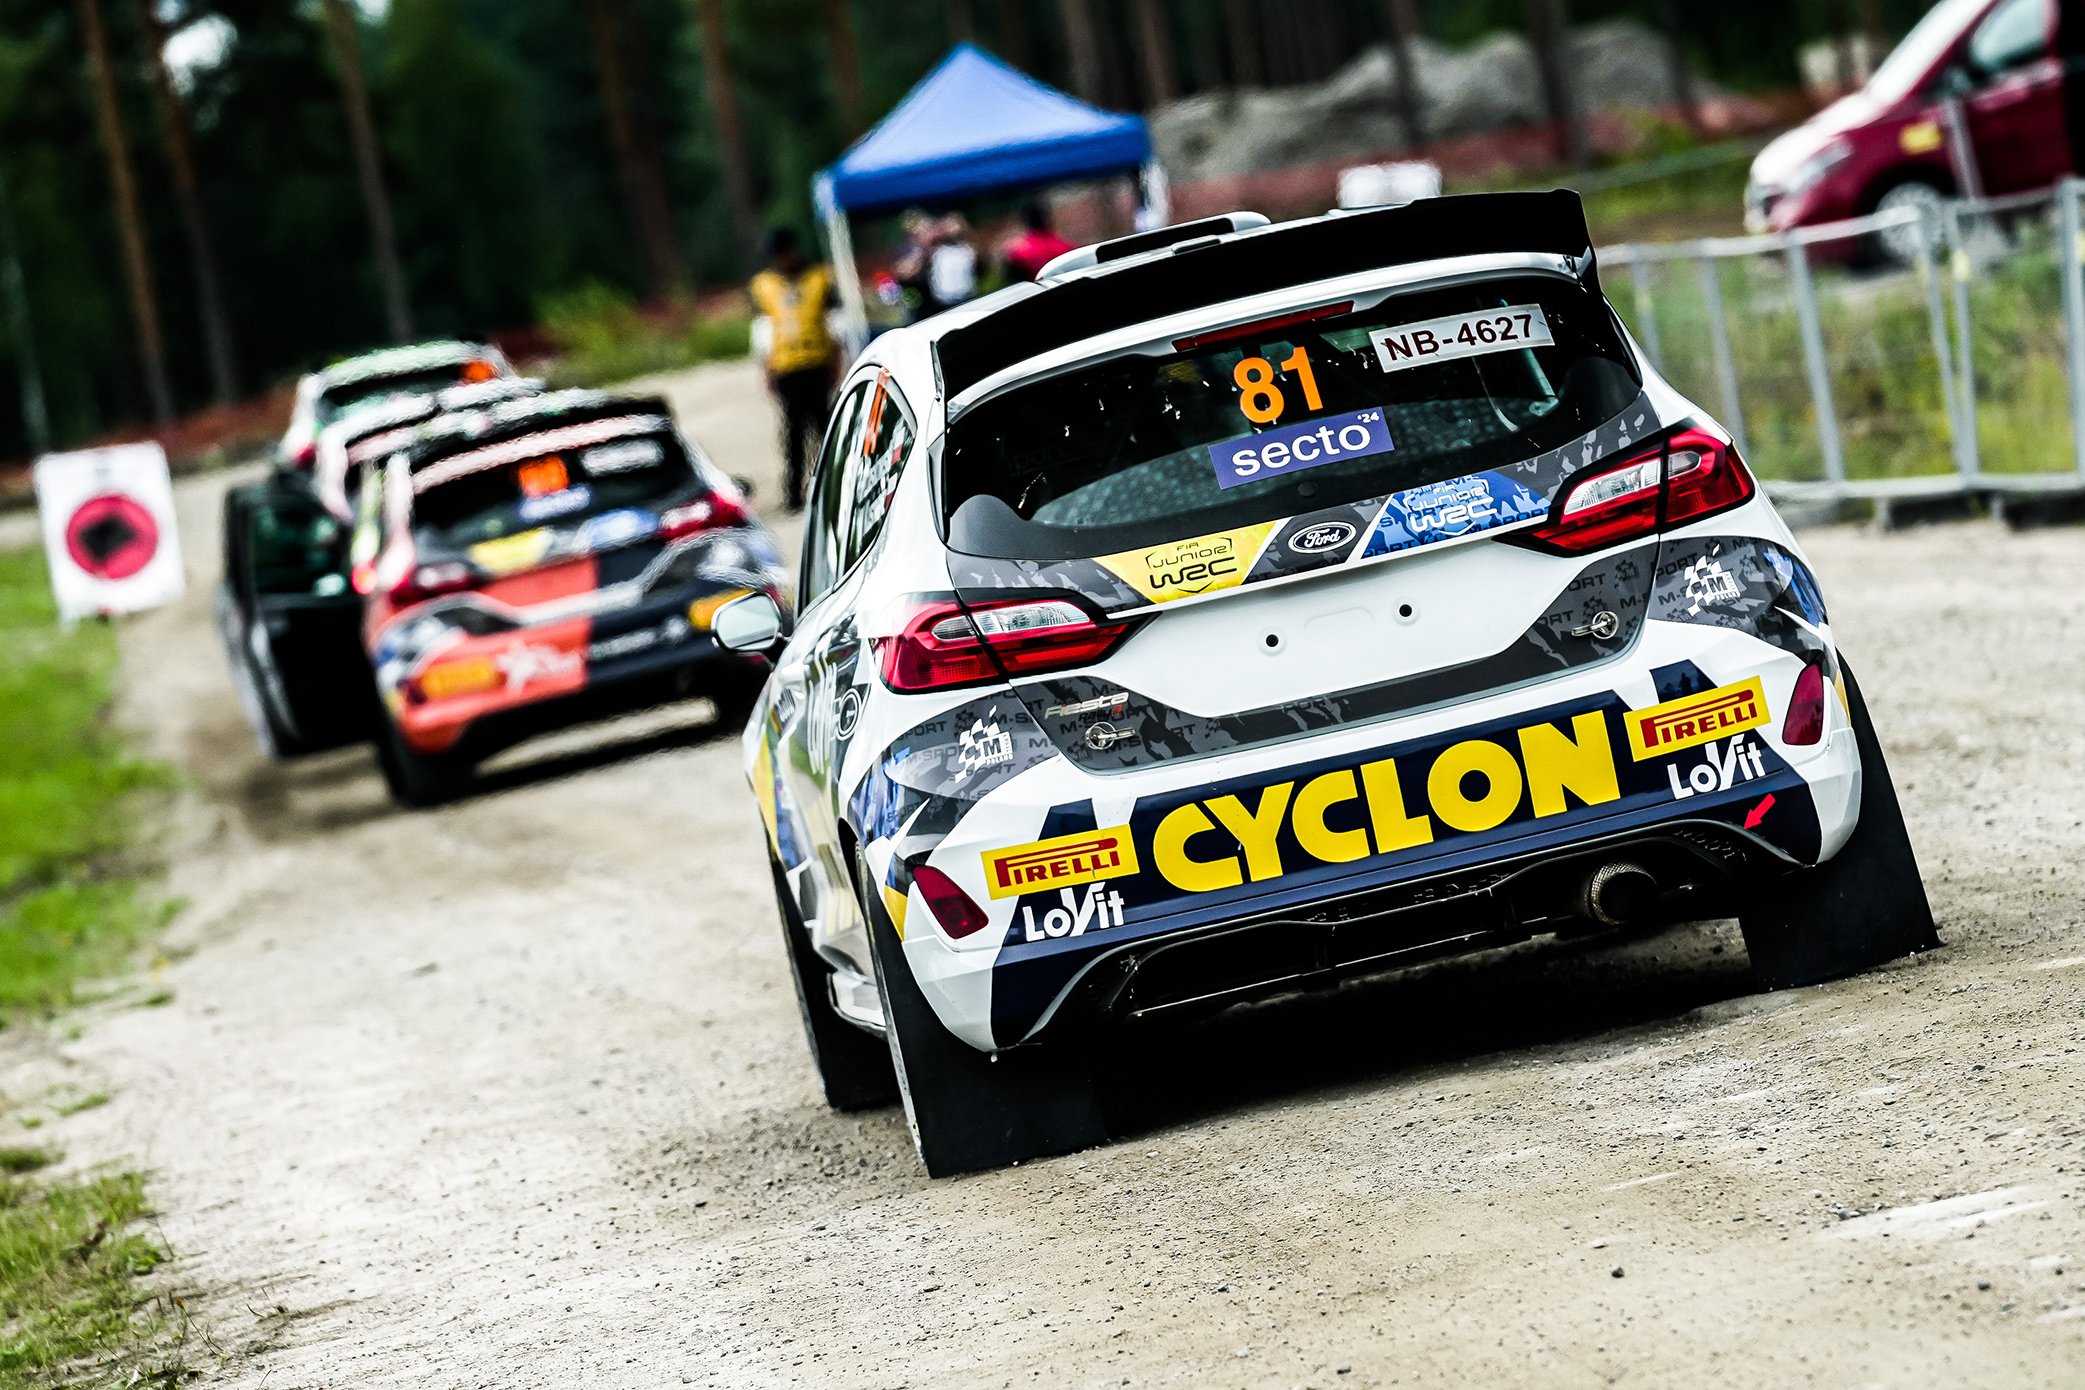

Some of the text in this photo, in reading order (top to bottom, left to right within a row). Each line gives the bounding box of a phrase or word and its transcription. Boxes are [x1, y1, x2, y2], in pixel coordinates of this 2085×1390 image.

[1385, 313, 1534, 362] NB-4627
[1233, 346, 1323, 423] 81
[1231, 423, 1371, 477] secto
[1410, 496, 1497, 532] WRC
[1412, 486, 1485, 511] JUNIOR
[1176, 541, 1199, 551] FIA
[1303, 528, 1341, 548] Ford
[1150, 556, 1237, 589] WRC
[1152, 545, 1229, 568] JUNIOR
[1044, 692, 1129, 720] Fiesta
[1640, 689, 1758, 749] PIRELLI
[1153, 709, 1621, 892] CYCLON
[994, 837, 1121, 888] PIRELLI
